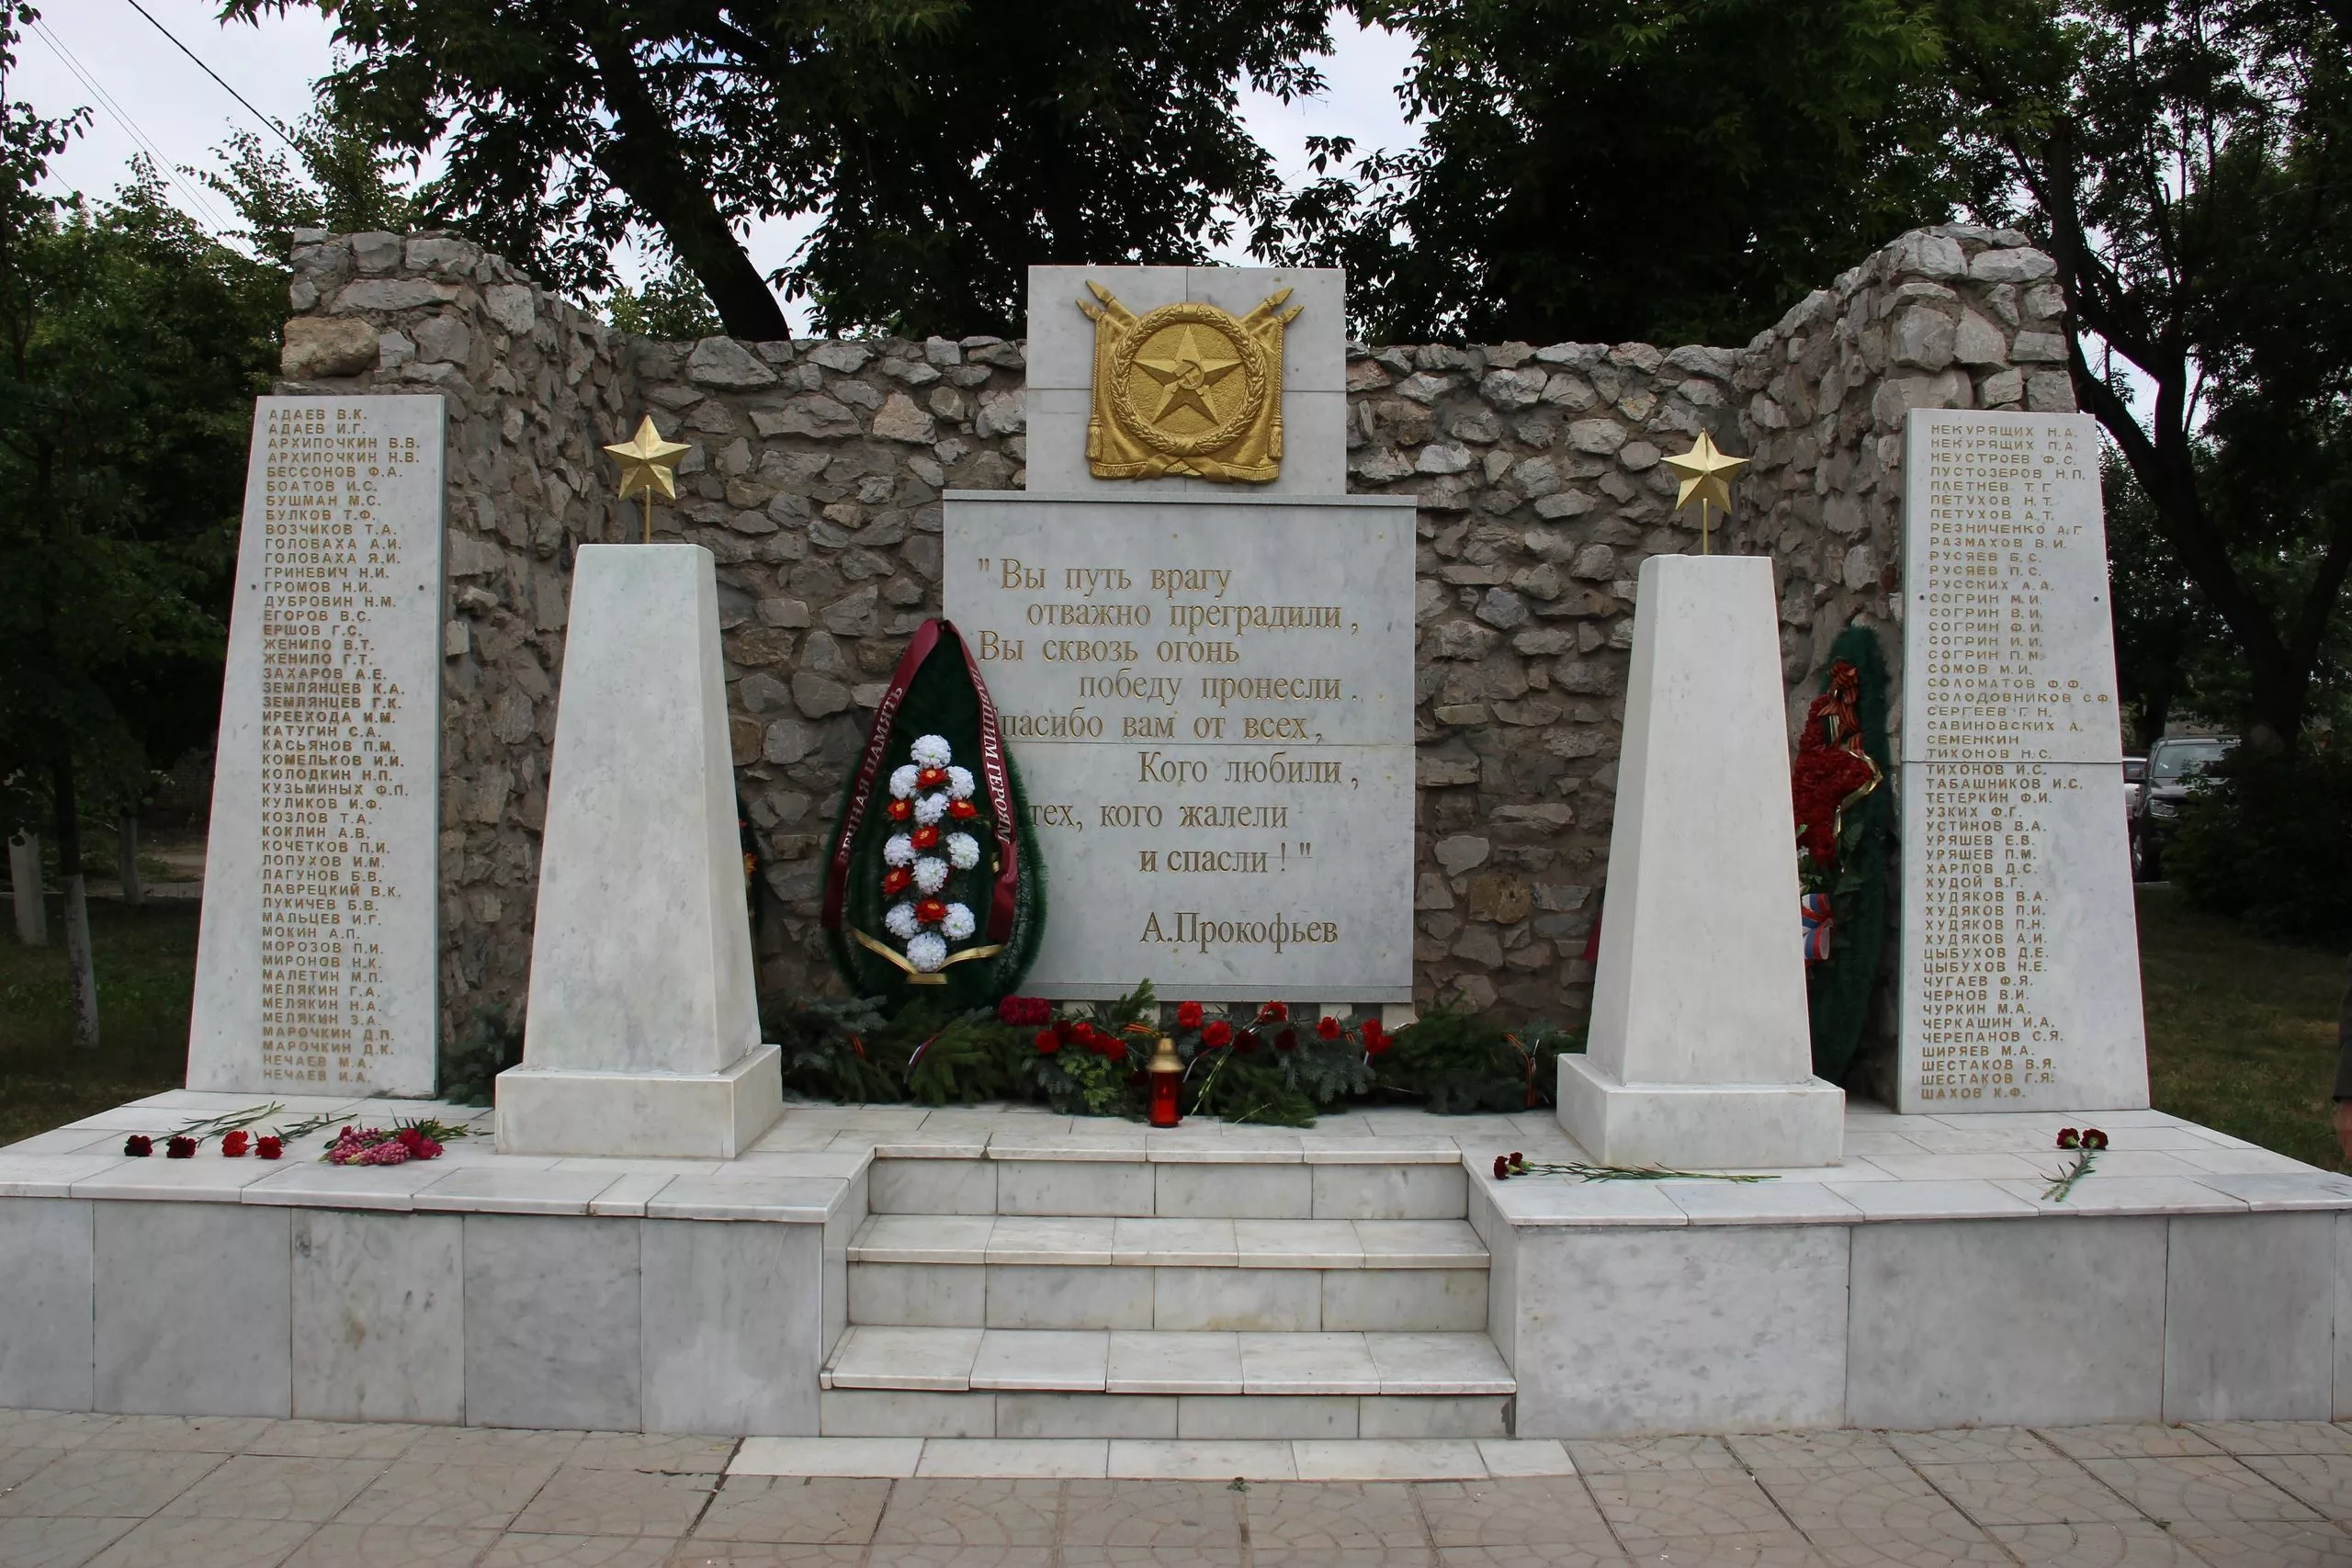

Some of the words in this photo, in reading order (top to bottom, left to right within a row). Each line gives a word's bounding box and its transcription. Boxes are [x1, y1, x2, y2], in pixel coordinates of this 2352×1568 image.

[269, 409, 325, 422] АДАЕВ
[268, 423, 325, 436] АДАЕВ
[1931, 424, 2034, 439] НЕКУРЯЩИХ
[268, 436, 378, 448] АРХИПОЧКИН
[1931, 438, 2034, 452] НЕКУРЯЩИХ
[267, 451, 377, 463] АРХИПОЧКИН
[1931, 450, 2030, 465] НЕУСТРОЕВ
[266, 466, 356, 478] БЕССОНОВ
[1931, 465, 2042, 479] ПУСТОЗЕРОВ
[266, 479, 334, 491] БОАТОВ
[1931, 479, 2009, 492] ПЛЕТНЕВ
[266, 495, 337, 507] БУШМАН
[1930, 492, 2010, 506] ПЕТУХОВ
[266, 508, 332, 520] БУЛКОВ
[1930, 507, 2011, 521] ПЕТУХОВ
[266, 523, 353, 535] ВОЗЧИКОВ
[1930, 521, 2045, 535] РЕЗНИЧЕНКО
[266, 537, 357, 549] ГОЛОВАХА
[1930, 536, 2023, 549] РАЗМАХОВ
[265, 551, 356, 563] ГОЛОВАХА
[1930, 549, 1998, 562] РУСЯЕВ
[265, 566, 348, 579] ГРИНЕВИЧ
[1930, 563, 1998, 576] РУСЯЕВ
[265, 580, 331, 592] ГРОМОВ
[1064, 566, 1132, 601] путь
[1149, 567, 1234, 601] врагу
[1929, 578, 2009, 591] РУССКИХ
[265, 594, 353, 608] ДУБРОВИН
[1929, 592, 1999, 604] СОГРИН
[264, 609, 329, 621] ЕГОРОВ
[1026, 603, 1152, 628] отважно
[1929, 605, 1999, 618] СОГРИН
[264, 624, 321, 636] ЕРШОВ
[1929, 620, 1999, 633] СОГРИН
[264, 637, 332, 650] ЖЕНИЛО
[977, 629, 1024, 663] Вы
[1042, 639, 1139, 664] сквозь
[1156, 639, 1240, 665] огонь
[1929, 634, 1998, 647] СОГРИН
[264, 651, 332, 664] ЖЕНИЛО
[1929, 648, 1998, 660] СОГРИН
[263, 667, 344, 680] ЗАХАРОВ
[1928, 662, 1988, 674] СОМОВ
[263, 681, 361, 695] ЗЕМЛЯНЦЕВ
[1079, 668, 1183, 707] победу
[1928, 677, 2036, 690] СОЛОМАТОВ
[263, 695, 361, 710] ЗЕМЛЯНЦЕВ
[1928, 691, 2072, 705] СОЛОДОВНИКОВ
[1928, 705, 2007, 716] СЕРГЕЕВ
[263, 710, 352, 725] ИРЕЕХОДА
[993, 705, 1104, 739] пасибо
[1121, 716, 1175, 739] вам
[1193, 716, 1227, 739] от
[263, 724, 338, 737] КАТУГИН
[865, 687, 903, 776] ПАМЯТЬ
[1928, 719, 2055, 731] САВИНОВСКИХ
[263, 739, 353, 752] КАСЬЯНОВ
[1927, 734, 2019, 746] СЕМЕНКИН
[263, 753, 362, 767] КОМЕЛЬКОВ
[1927, 748, 2009, 760] ТИХОНОВ
[1137, 750, 1208, 785] Кого
[1926, 763, 2004, 775] ТИХОНОВ
[263, 767, 351, 782] КОЛОДКИН
[263, 783, 364, 796] КУЗЬМИНЫХ
[1926, 778, 2041, 790] ТАБАШНИКОВ
[263, 795, 338, 809] КУЛИКОВ
[986, 762, 1012, 844] ГЕРОЯМ
[1926, 791, 2008, 802] ТЕТЕРКИН
[263, 810, 328, 823] КОЗЛОВ
[1028, 803, 1083, 832] тех,
[1101, 803, 1164, 829] кого
[1179, 803, 1290, 829] жалели
[1926, 806, 1978, 817] УЗКИХ
[263, 825, 326, 838] КОКЛИН
[1926, 820, 2003, 831] УСТИНОВ
[263, 838, 348, 852] КОЧЕТКОВ
[1926, 833, 1993, 845] УРЯШЕВ
[263, 852, 342, 866] ЛОПУХОВ
[1926, 847, 1993, 859] УРЯШЕВ
[1138, 850, 1159, 874] и
[1926, 863, 1994, 874] ХАРЛОВ
[263, 867, 340, 881] ЛАГУНОВ
[262, 879, 360, 897] ЛАВРЕЦКИЙ
[1926, 874, 1983, 889] ХУДОЙ
[262, 897, 336, 910] ЛУКИЧЕВ
[1926, 890, 2004, 904] ХУДЯКОВ
[1926, 904, 2004, 918] ХУДЯКОВ
[262, 911, 341, 927] МАЛЬЦЕВ
[1926, 919, 2004, 932] ХУДЯКОВ
[262, 925, 317, 939] МОКИН
[1926, 932, 2004, 946] ХУДЯКОВ
[262, 939, 342, 953] МОРОЗОВ
[262, 953, 341, 968] МИРОНОВ
[1924, 948, 2006, 962] ЦЫБУХОВ
[262, 967, 340, 982] МАЛЕТИН
[1924, 961, 2006, 976] ЦЫБУХОВ
[1924, 975, 1988, 987] ЧУГАЕВ
[263, 982, 339, 997] МЕЛЯКИН
[1923, 988, 1987, 1000] ЧЕРНОВ
[263, 996, 339, 1010] МЕЛЯКИН
[1923, 1003, 1986, 1015] ЧУРКИН
[263, 1010, 339, 1025] МЕЛЯКИН
[1923, 1016, 2012, 1029] ЧЕРКАШИН
[263, 1025, 352, 1041] МАРОЧКИН
[1923, 1030, 2020, 1043] ЧЕРЕПАНОВ
[263, 1039, 352, 1055] МАРОЧКИН
[1922, 1044, 1990, 1057] ШИРЯЕВ
[263, 1053, 327, 1067] НЕЧАЕВ
[1922, 1058, 2014, 1071] ШЕСТАКОВ
[263, 1067, 327, 1082] НЕЧАЕВ
[1921, 1071, 2014, 1086] ШЕСТАКОВ
[1921, 1088, 1982, 1101] ШАХОВ
